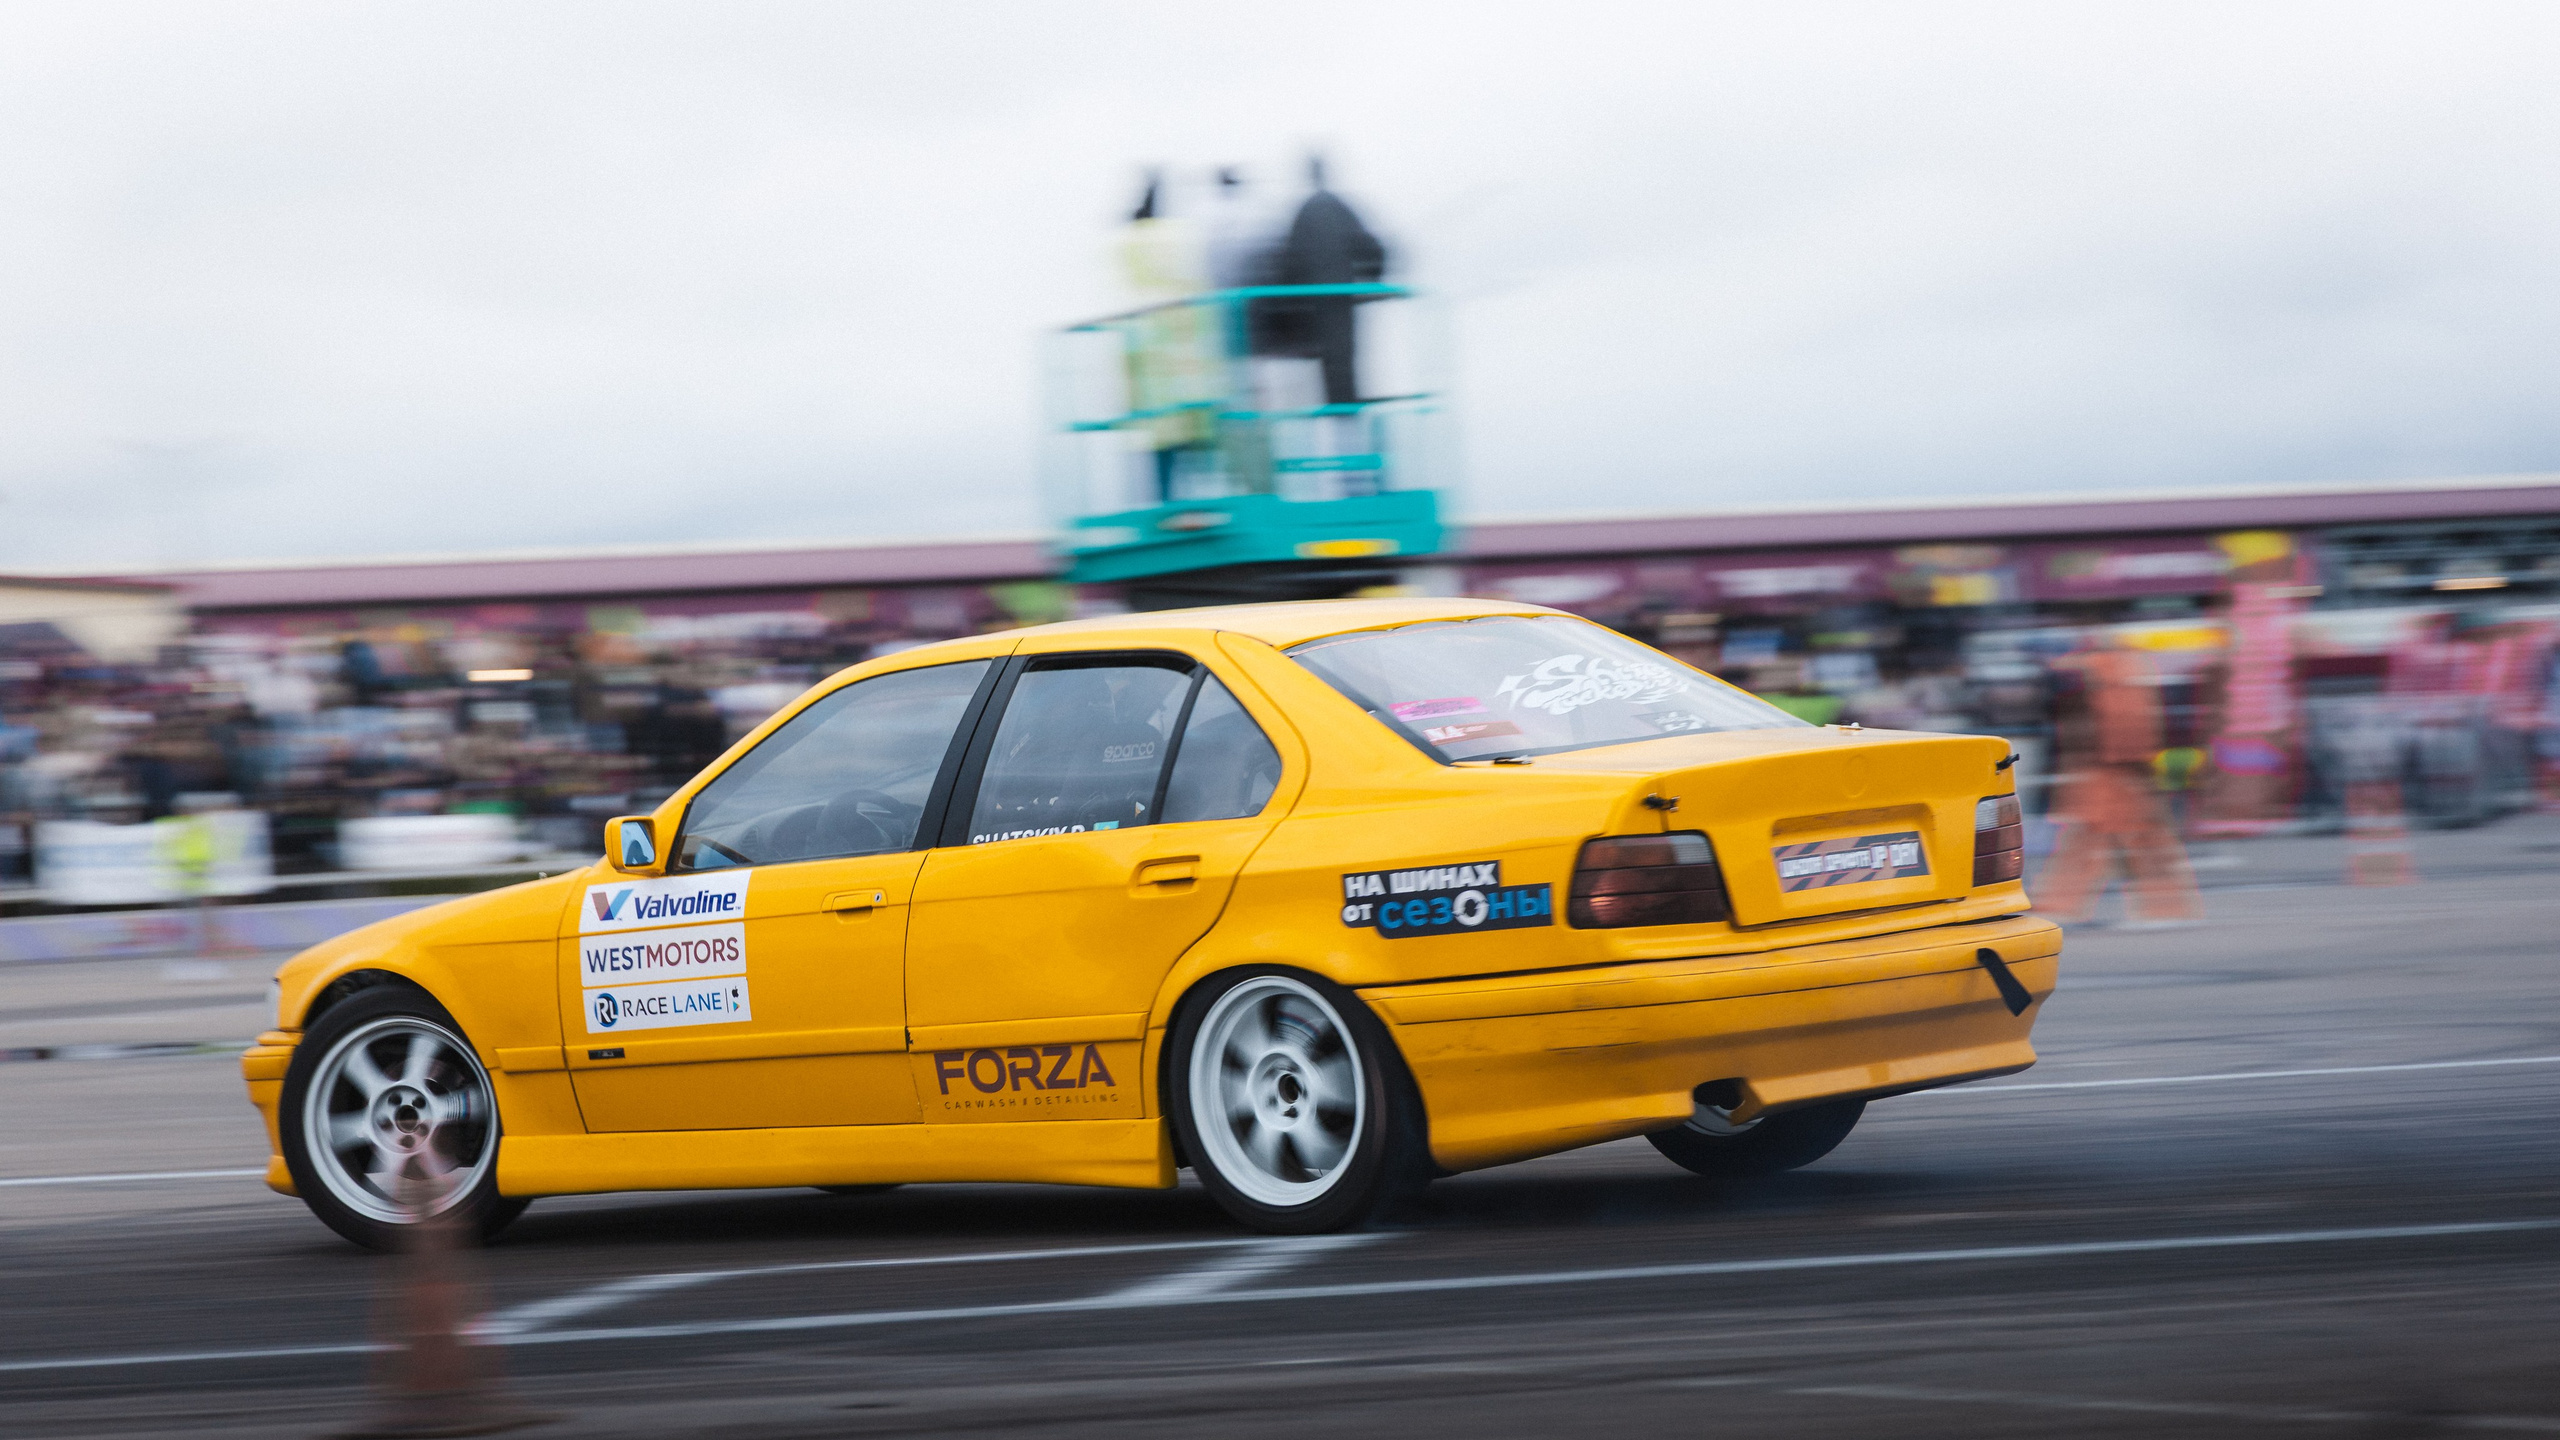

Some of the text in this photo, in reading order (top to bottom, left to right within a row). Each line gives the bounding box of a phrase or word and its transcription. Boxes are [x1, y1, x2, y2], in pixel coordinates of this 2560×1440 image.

[1103, 741, 1155, 762] sparco
[1345, 863, 1498, 898] НА ШИНАХ
[634, 890, 737, 919] Valvoline
[586, 936, 740, 973] WESTMOTORS
[622, 996, 669, 1017] RACE
[672, 992, 722, 1013] LANE
[933, 1043, 1116, 1095] FORZA
[944, 1093, 1119, 1110] CARWASH DETAILING
